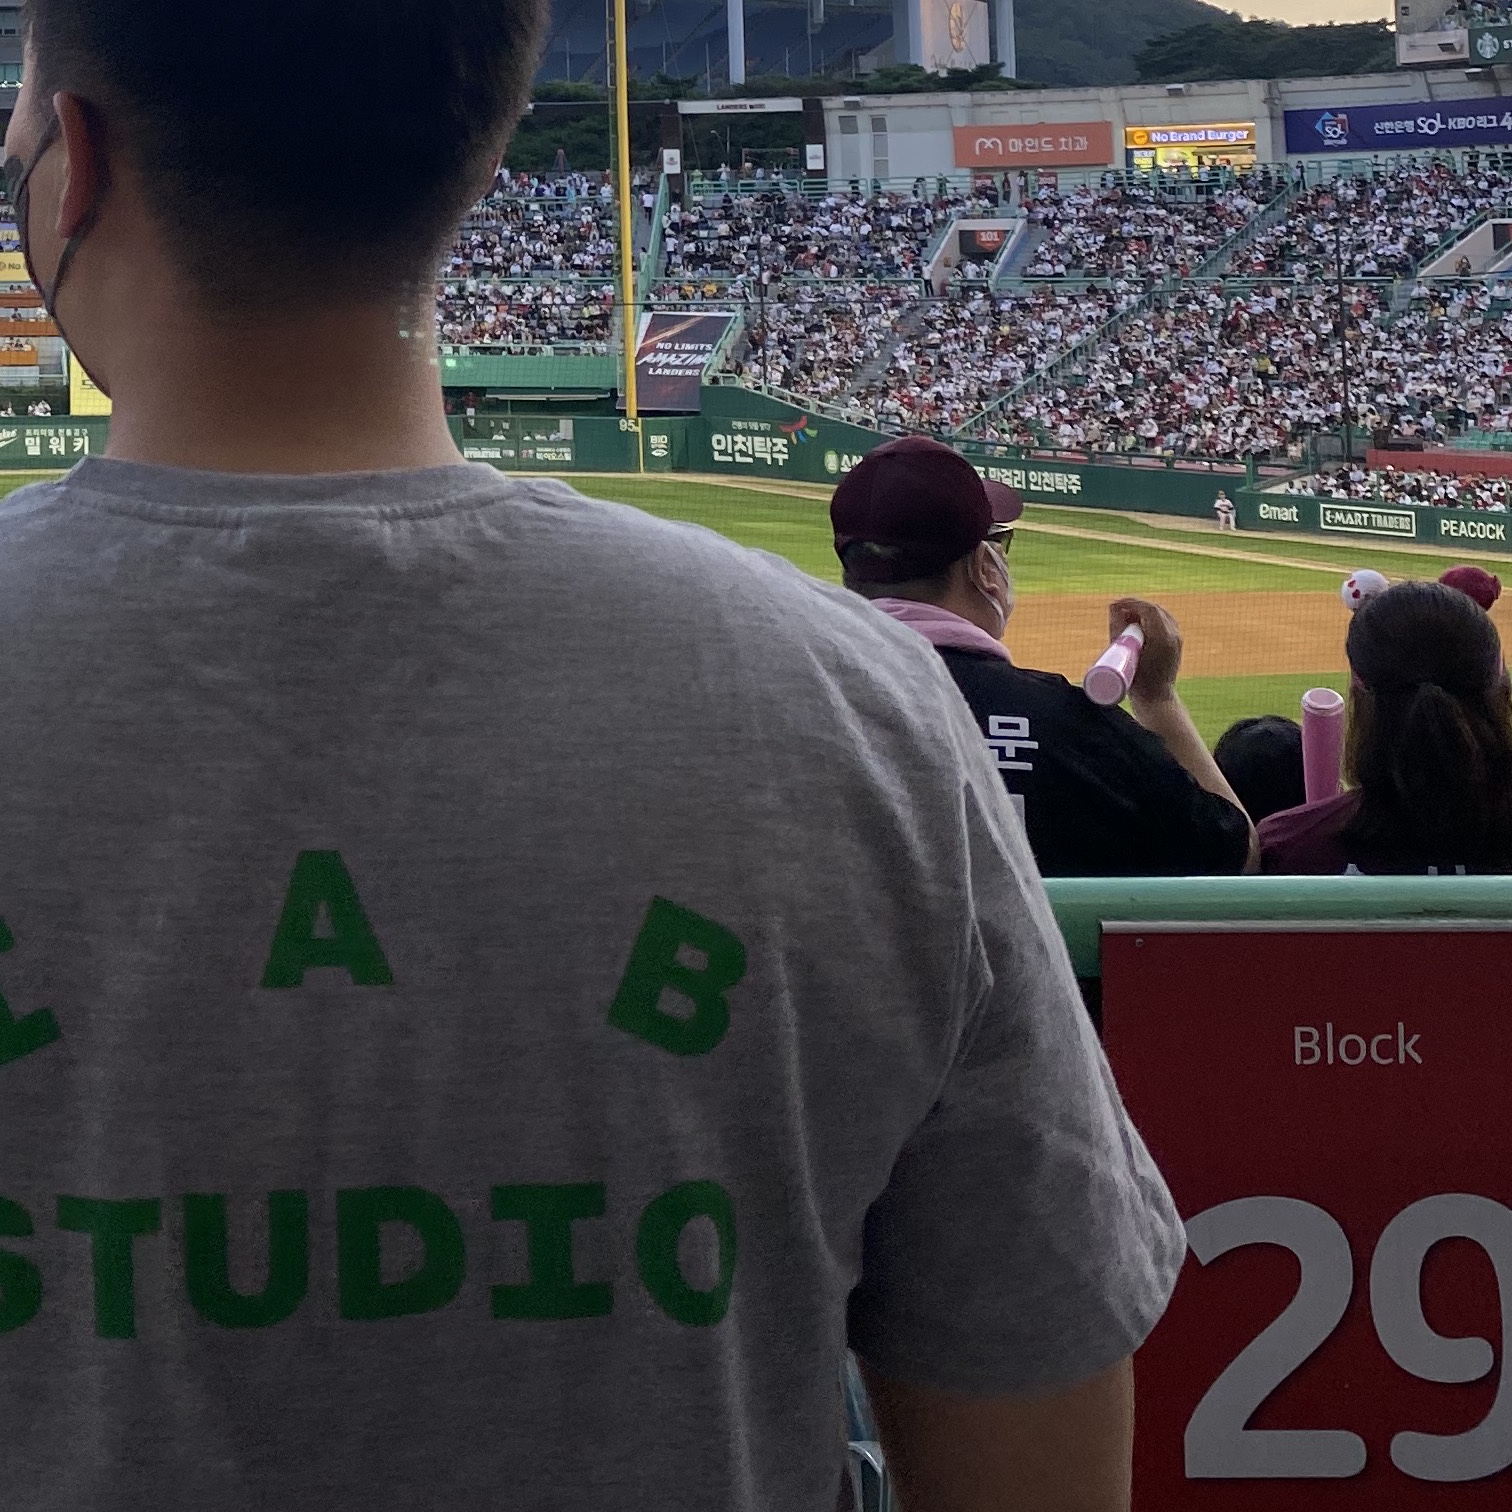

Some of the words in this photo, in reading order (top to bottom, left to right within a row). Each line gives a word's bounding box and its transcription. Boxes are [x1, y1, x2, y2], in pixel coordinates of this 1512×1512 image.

[1374, 120, 1414, 135] 신한은행
[1417, 113, 1446, 135] SOL
[1008, 137, 1054, 153] 마인드
[1058, 136, 1088, 151] 치과
[1151, 132, 1169, 142] No
[1170, 129, 1205, 142] Brand
[1207, 129, 1249, 142] Burger
[980, 231, 1000, 242] 101
[648, 368, 701, 376] LANDERS
[711, 433, 788, 466] 인천탁주
[1029, 470, 1082, 495] 인천탁주
[1259, 502, 1299, 523] emart
[1372, 513, 1411, 530] TRADERS
[1440, 518, 1506, 541] PEACOCK
[1293, 1022, 1423, 1065] Block
[1184, 1193, 1512, 1482] 29
